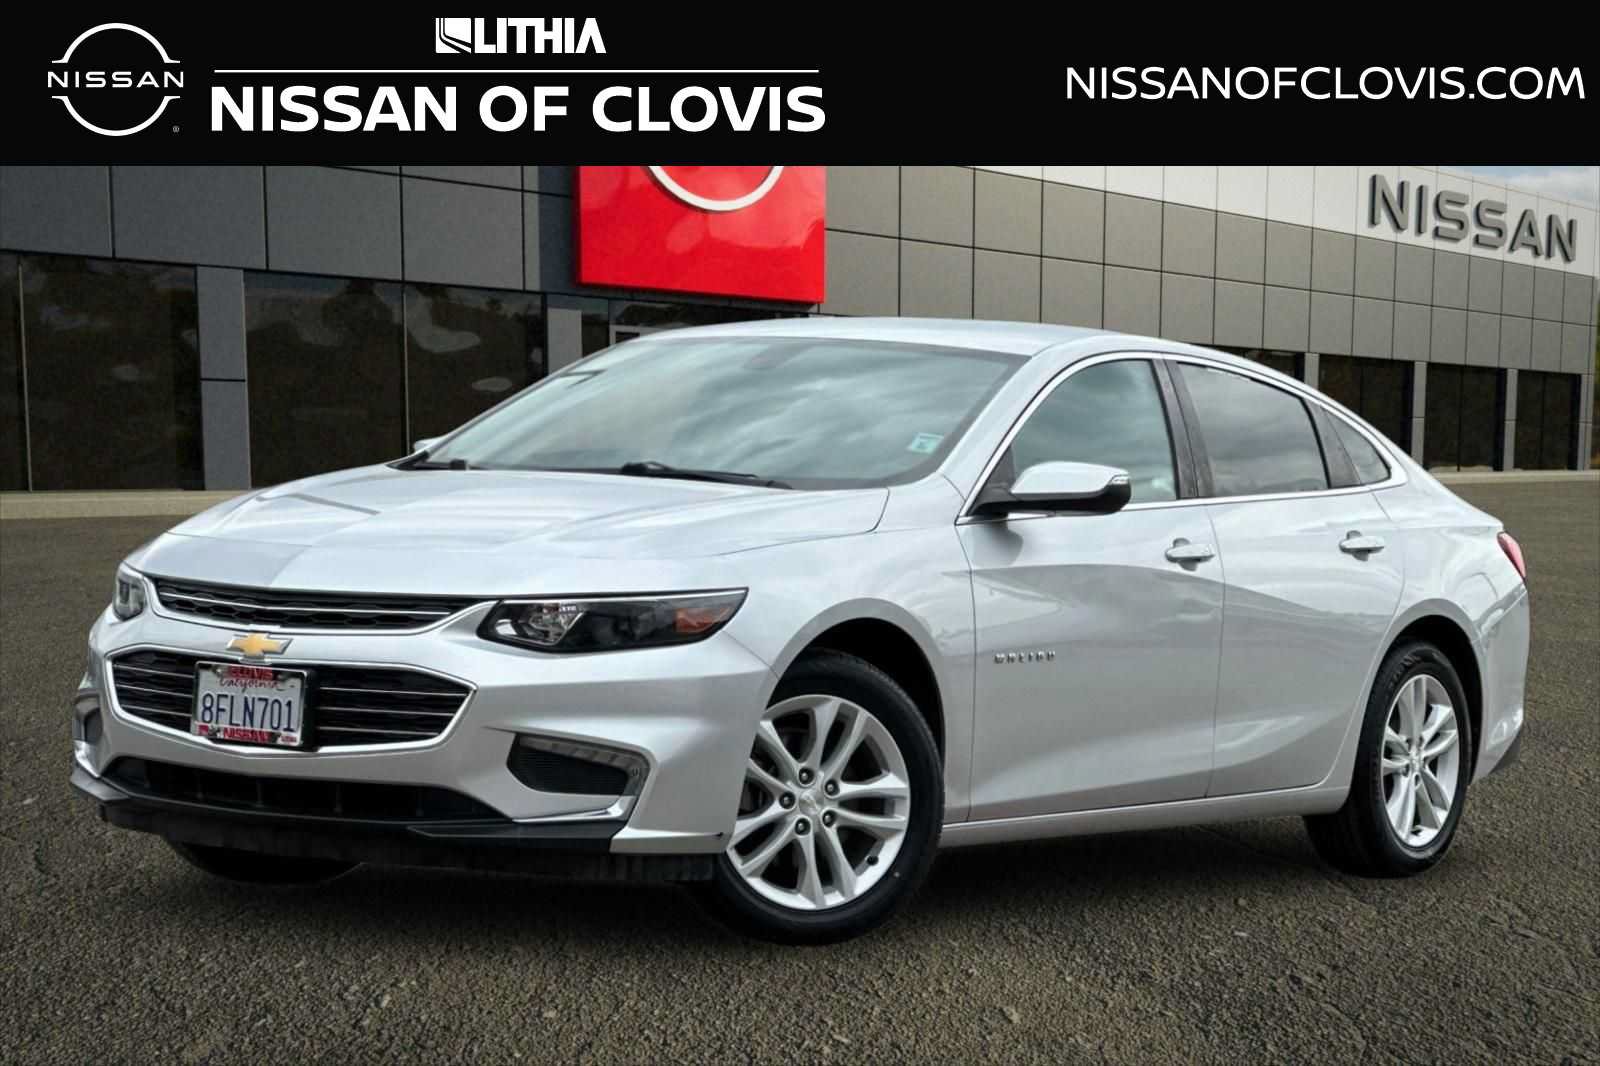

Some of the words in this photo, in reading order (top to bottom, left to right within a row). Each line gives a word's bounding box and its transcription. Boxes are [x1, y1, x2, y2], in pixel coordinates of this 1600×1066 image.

[1368, 173, 1578, 263] NISSAN
[200, 691, 297, 733] 8FLN701
[223, 727, 270, 744] NISSAN
